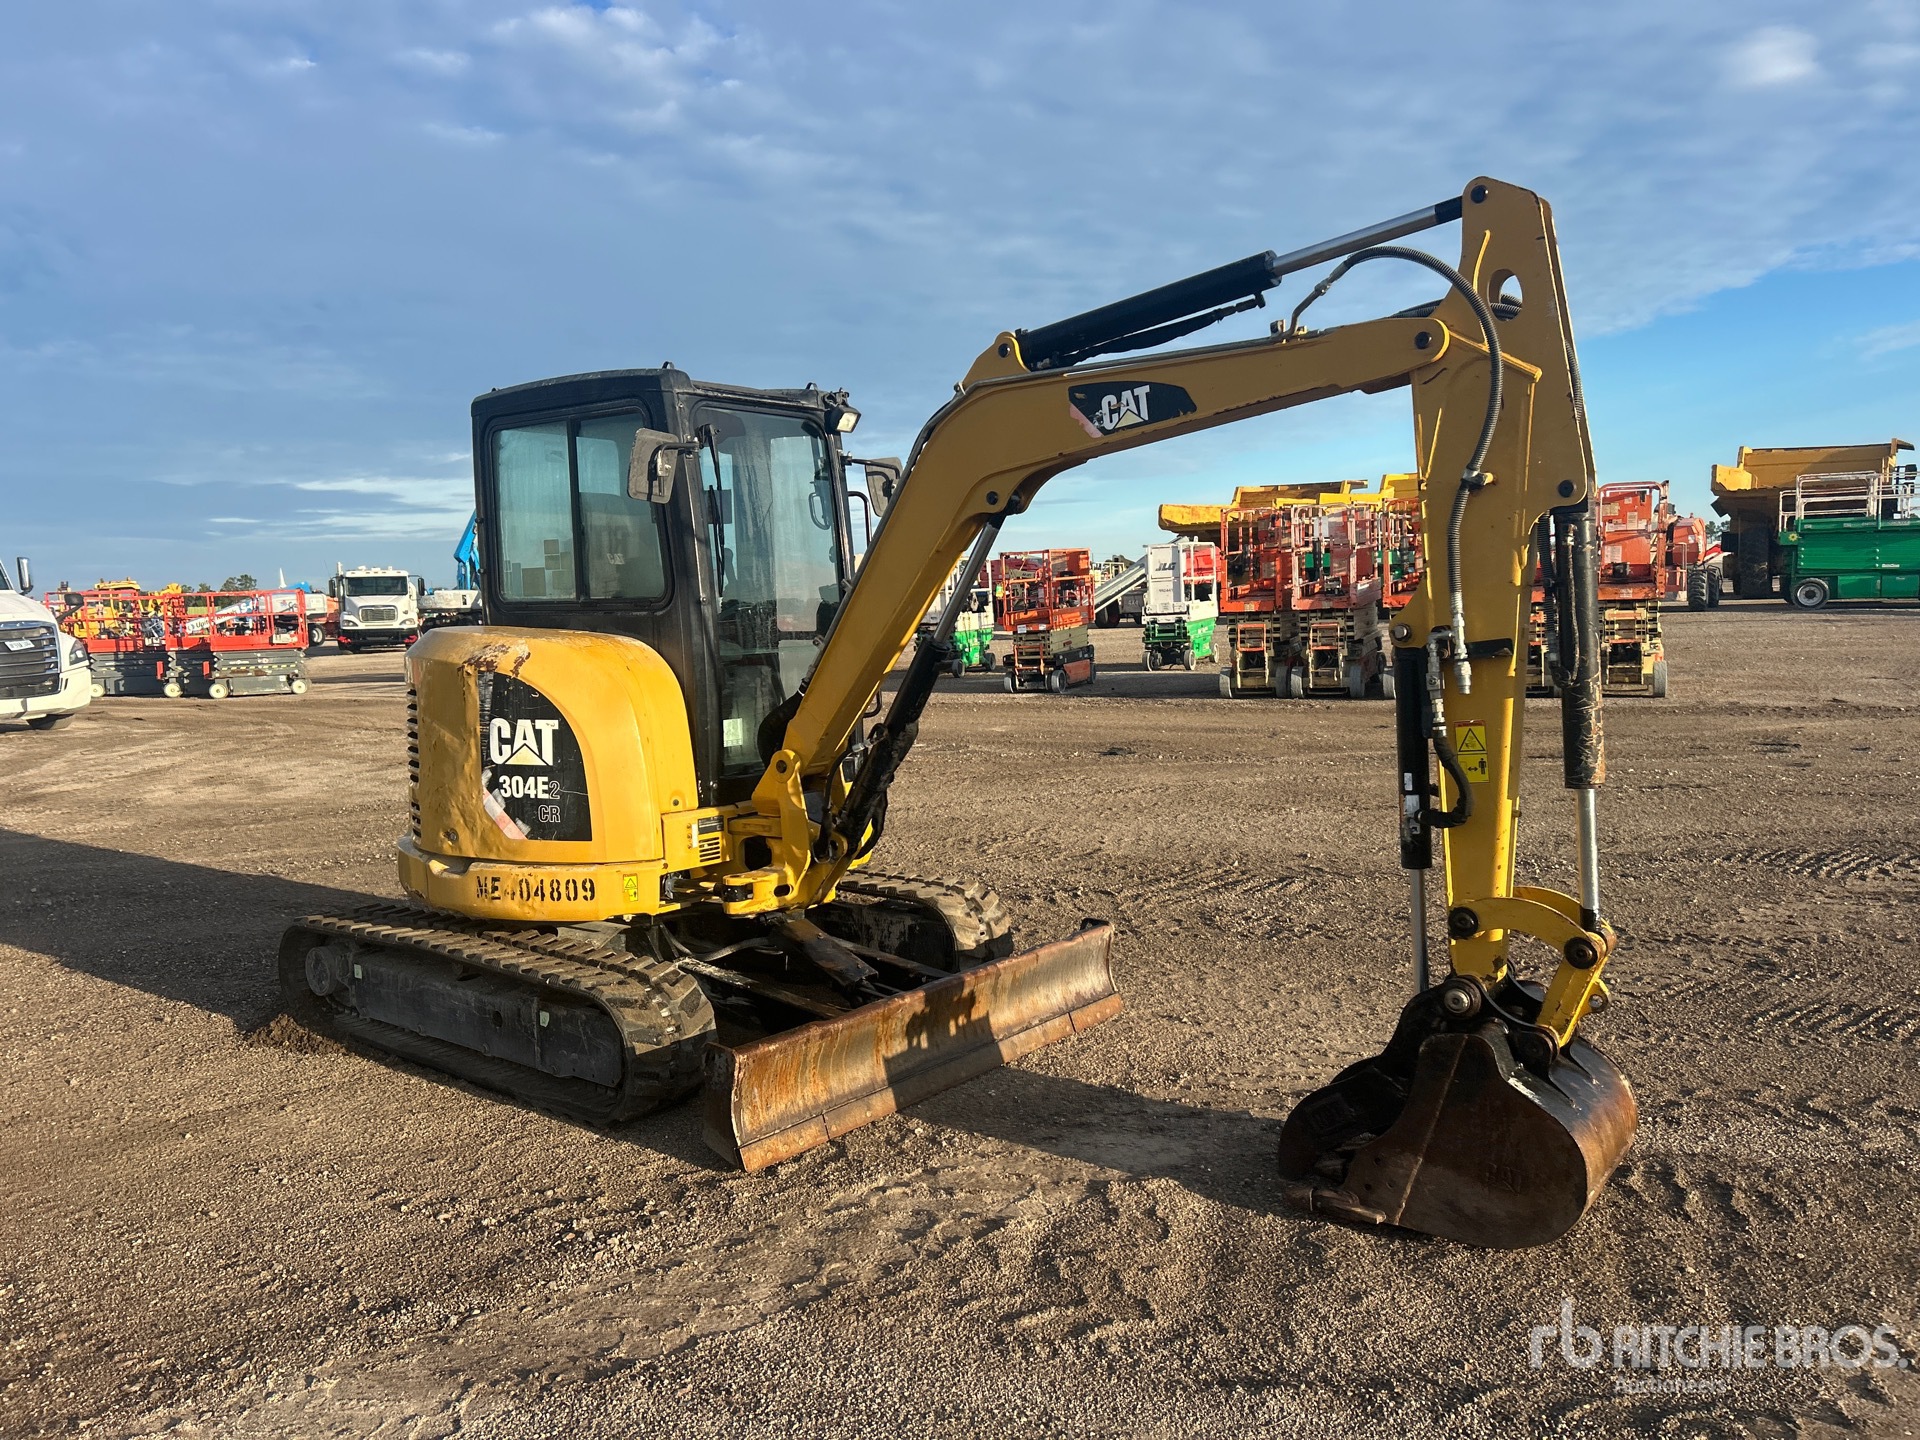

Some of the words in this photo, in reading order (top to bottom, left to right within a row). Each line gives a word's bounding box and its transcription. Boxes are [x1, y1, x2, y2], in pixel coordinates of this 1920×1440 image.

[1101, 384, 1150, 430] CAT
[606, 553, 625, 565] CAT
[1155, 562, 1176, 571] JLG
[490, 717, 559, 766] CAT
[498, 774, 561, 800] 304E2
[538, 804, 561, 823] CR
